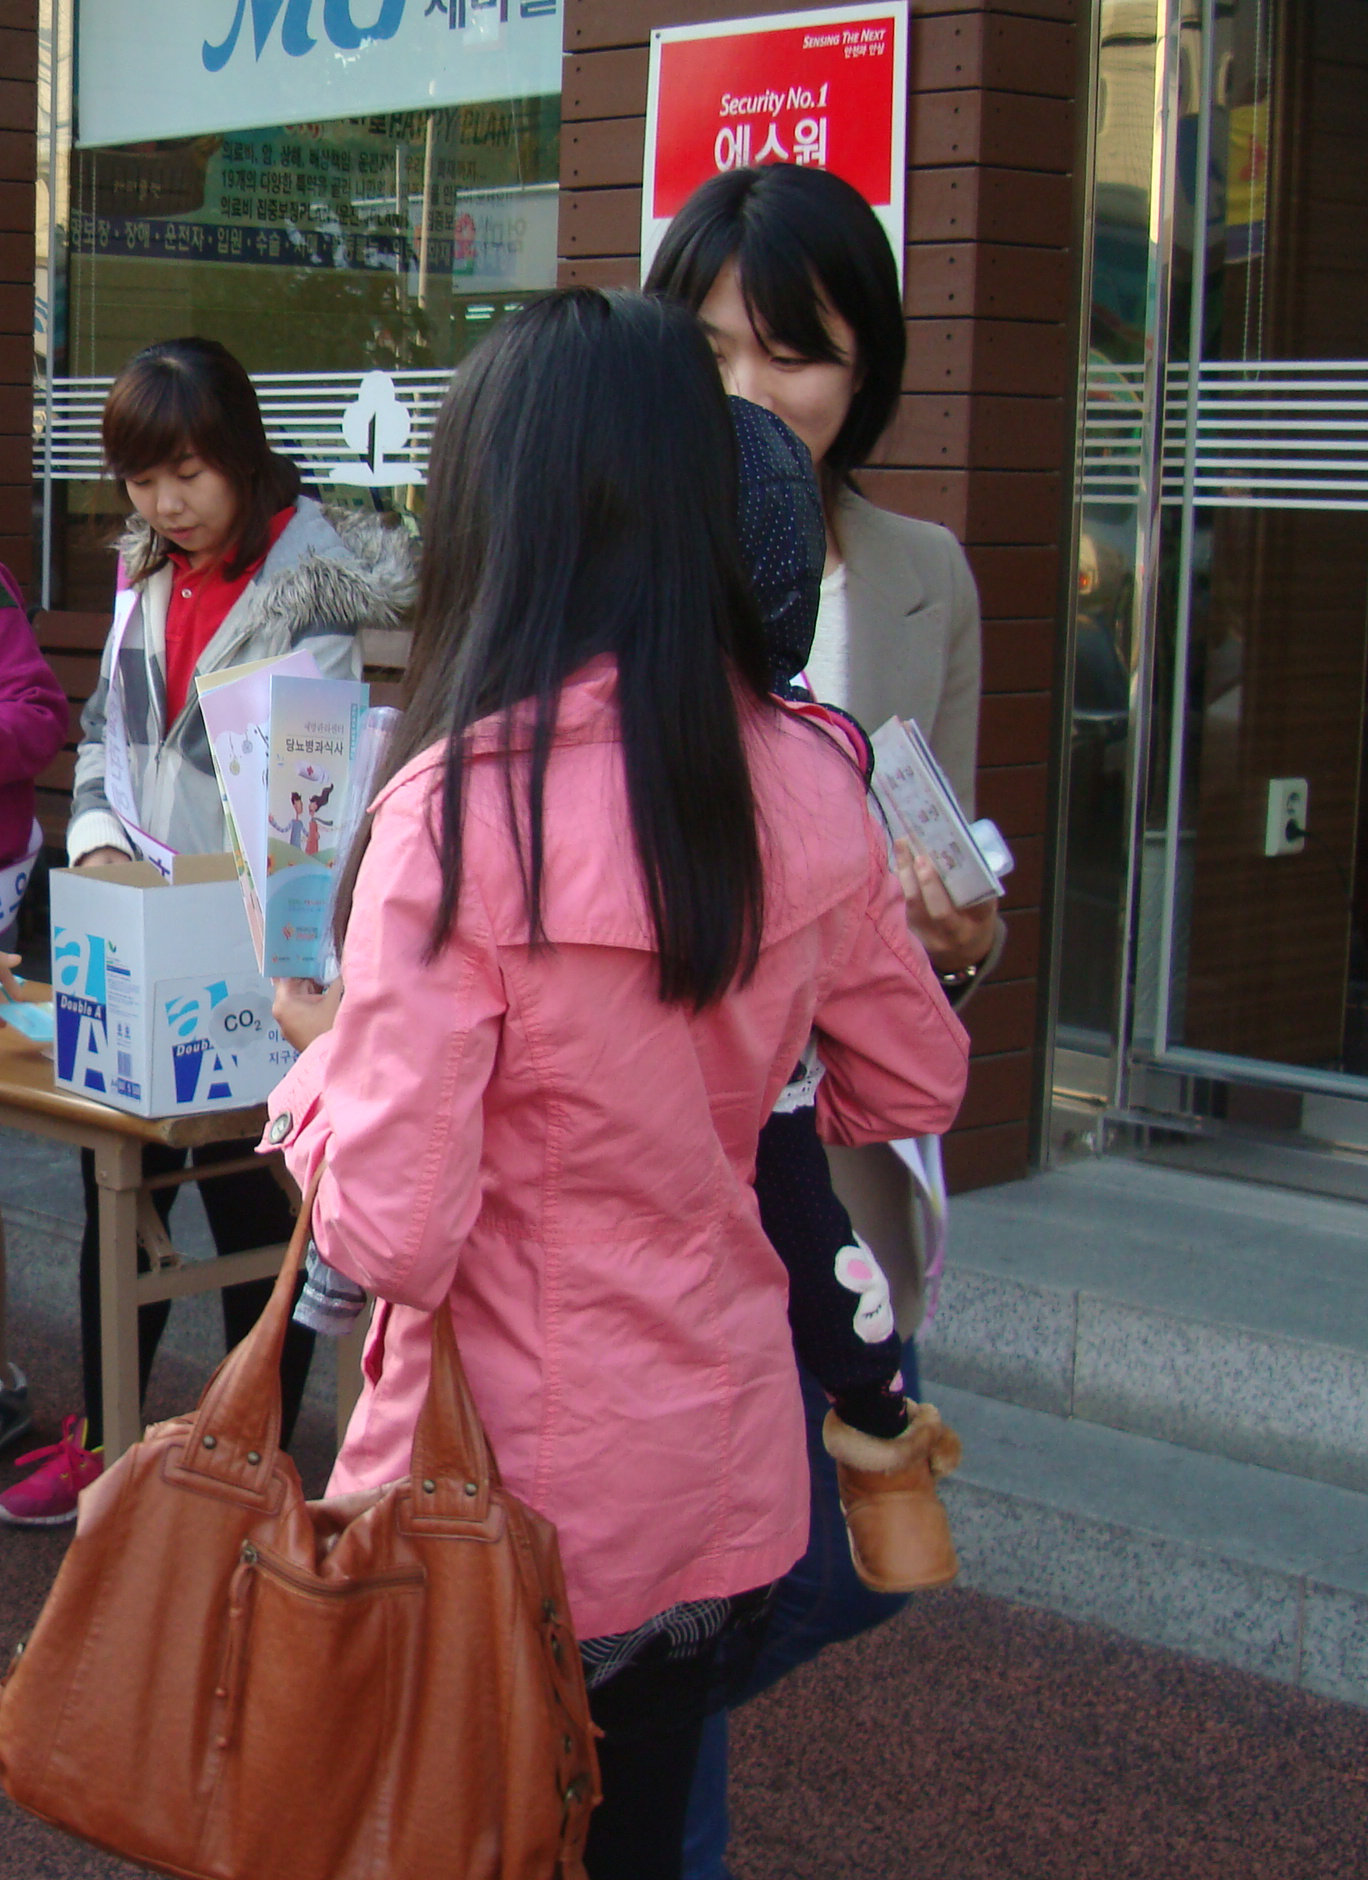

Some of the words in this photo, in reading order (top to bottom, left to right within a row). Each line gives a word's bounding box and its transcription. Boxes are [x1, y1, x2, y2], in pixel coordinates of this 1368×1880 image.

[719, 89, 785, 117] Security
[714, 117, 827, 172] 에스원
[284, 737, 344, 757] 당뇨병과식사
[59, 996, 92, 1018] Double
[92, 1004, 103, 1020] A
